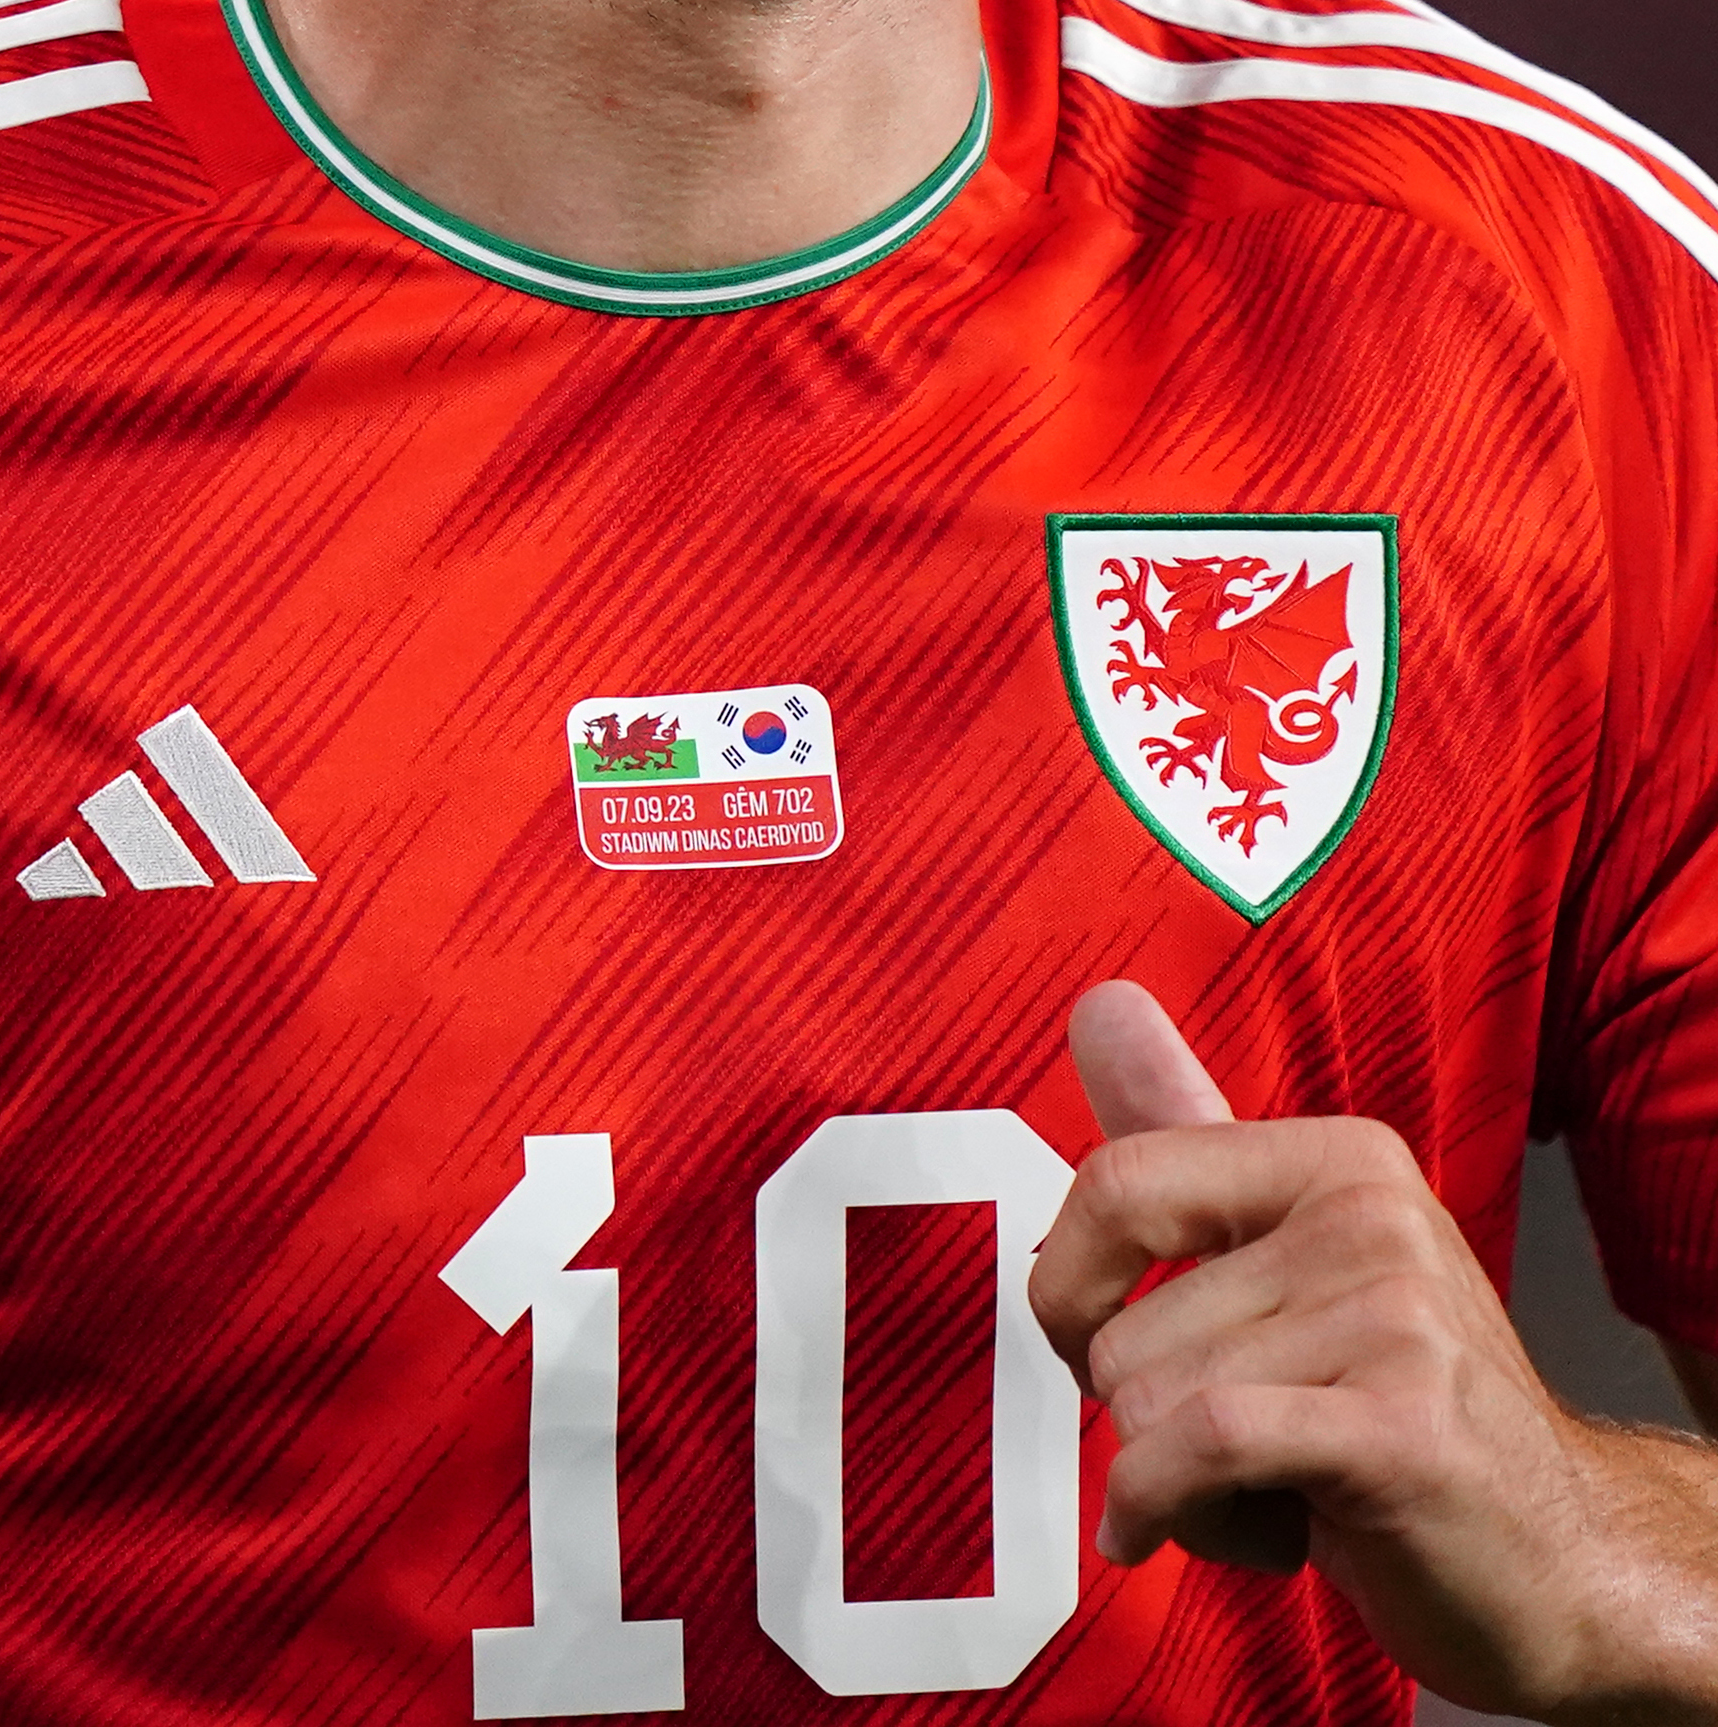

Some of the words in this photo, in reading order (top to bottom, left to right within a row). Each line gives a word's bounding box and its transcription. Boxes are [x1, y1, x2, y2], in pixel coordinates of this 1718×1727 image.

[602, 794, 696, 824] 07.09.23
[723, 786, 769, 819] GÊM
[771, 787, 814, 815] 702
[601, 830, 679, 854] STADIWM
[684, 827, 732, 852] DINAS
[734, 821, 825, 849] CAERDYDD
[438, 1108, 1081, 1721] 10
